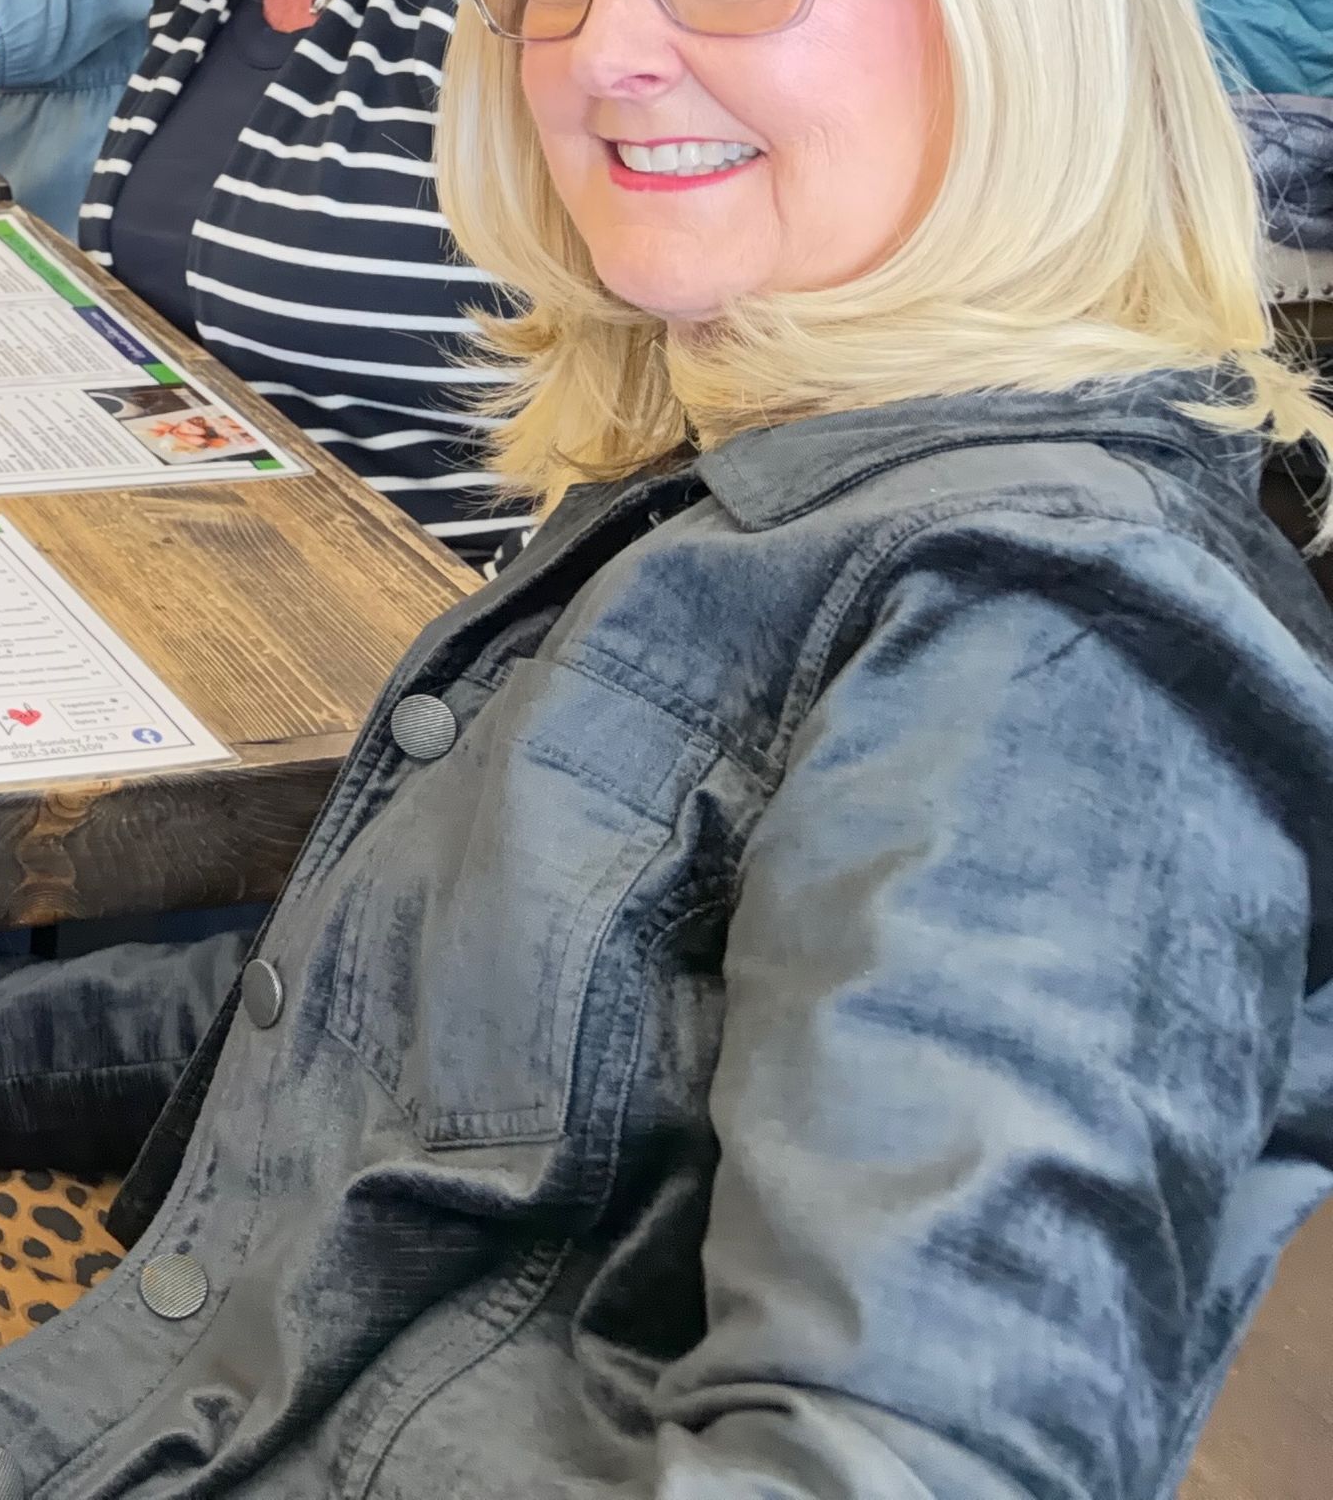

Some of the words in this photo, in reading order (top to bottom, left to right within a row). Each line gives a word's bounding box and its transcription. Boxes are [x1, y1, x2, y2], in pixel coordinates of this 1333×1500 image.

[84, 734, 94, 743] 7
[95, 734, 108, 742] to
[110, 732, 119, 741] 3
